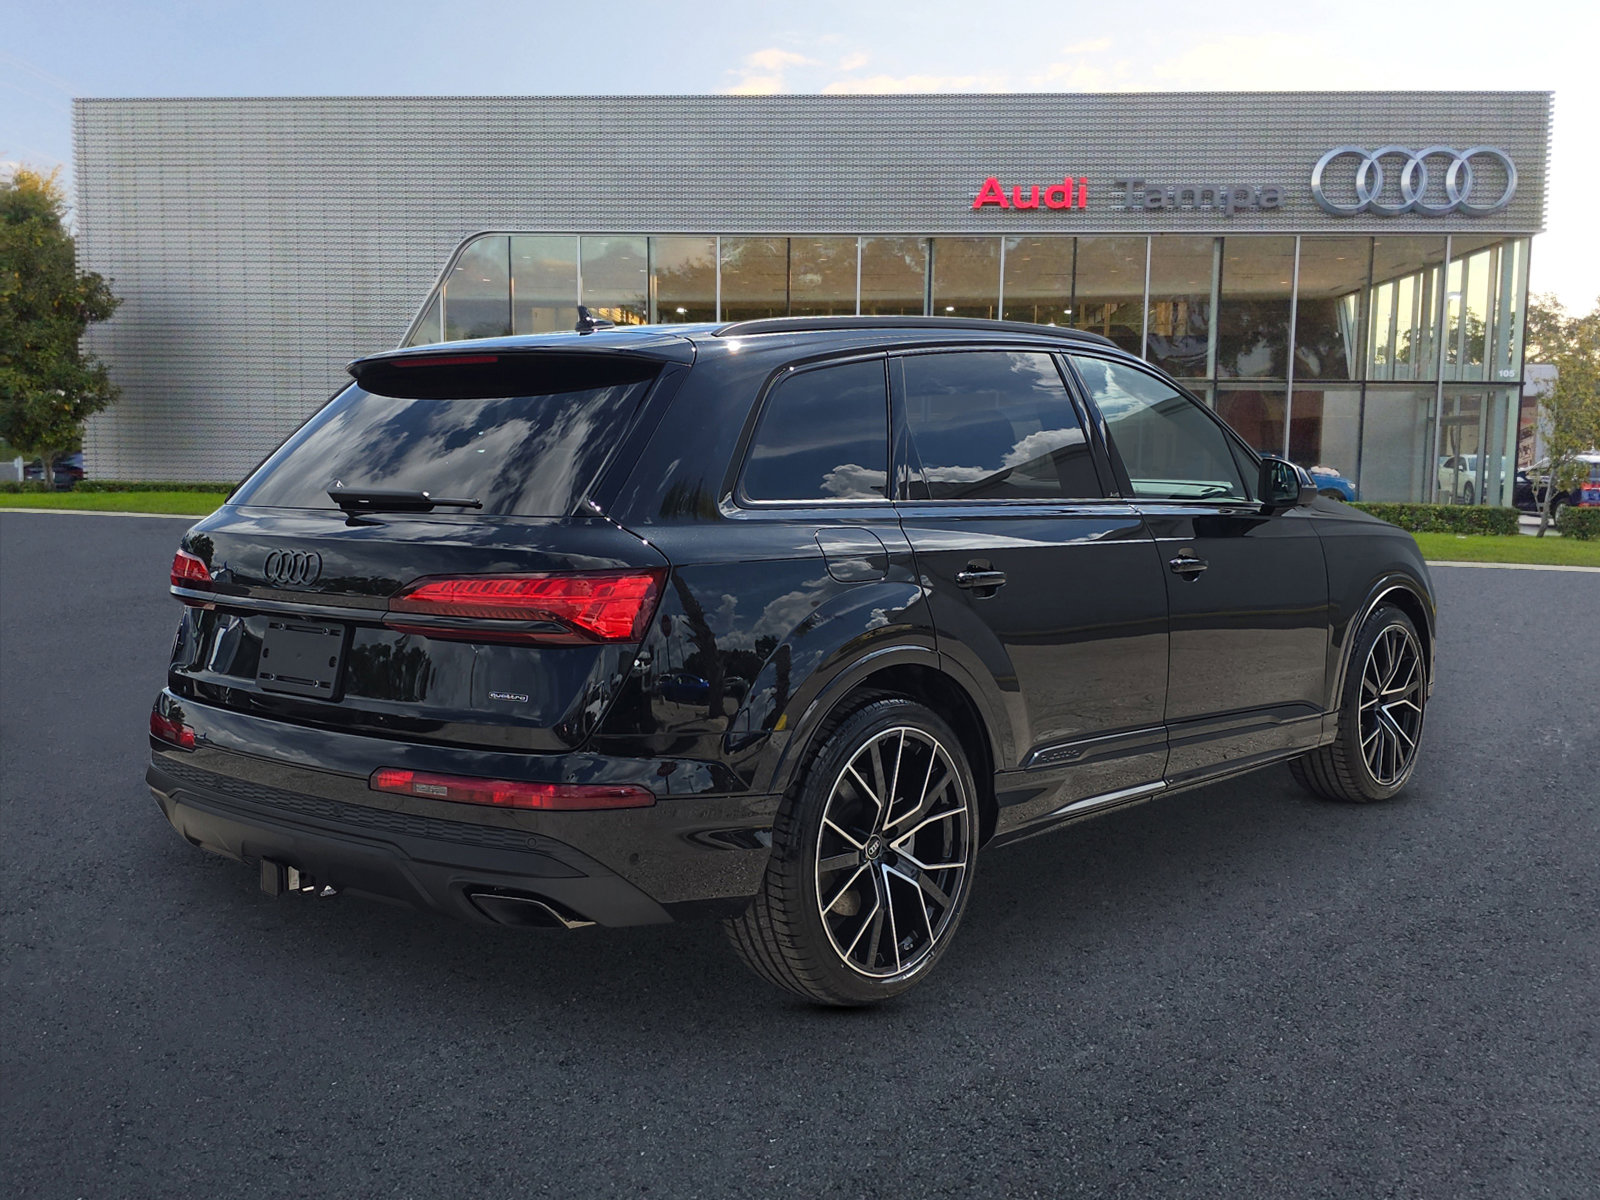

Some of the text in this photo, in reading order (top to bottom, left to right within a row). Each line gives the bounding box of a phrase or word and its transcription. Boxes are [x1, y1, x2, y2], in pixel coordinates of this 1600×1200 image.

[972, 177, 1286, 218] Audi Tampa
[1499, 369, 1515, 378] 105
[489, 692, 527, 701] quattro
